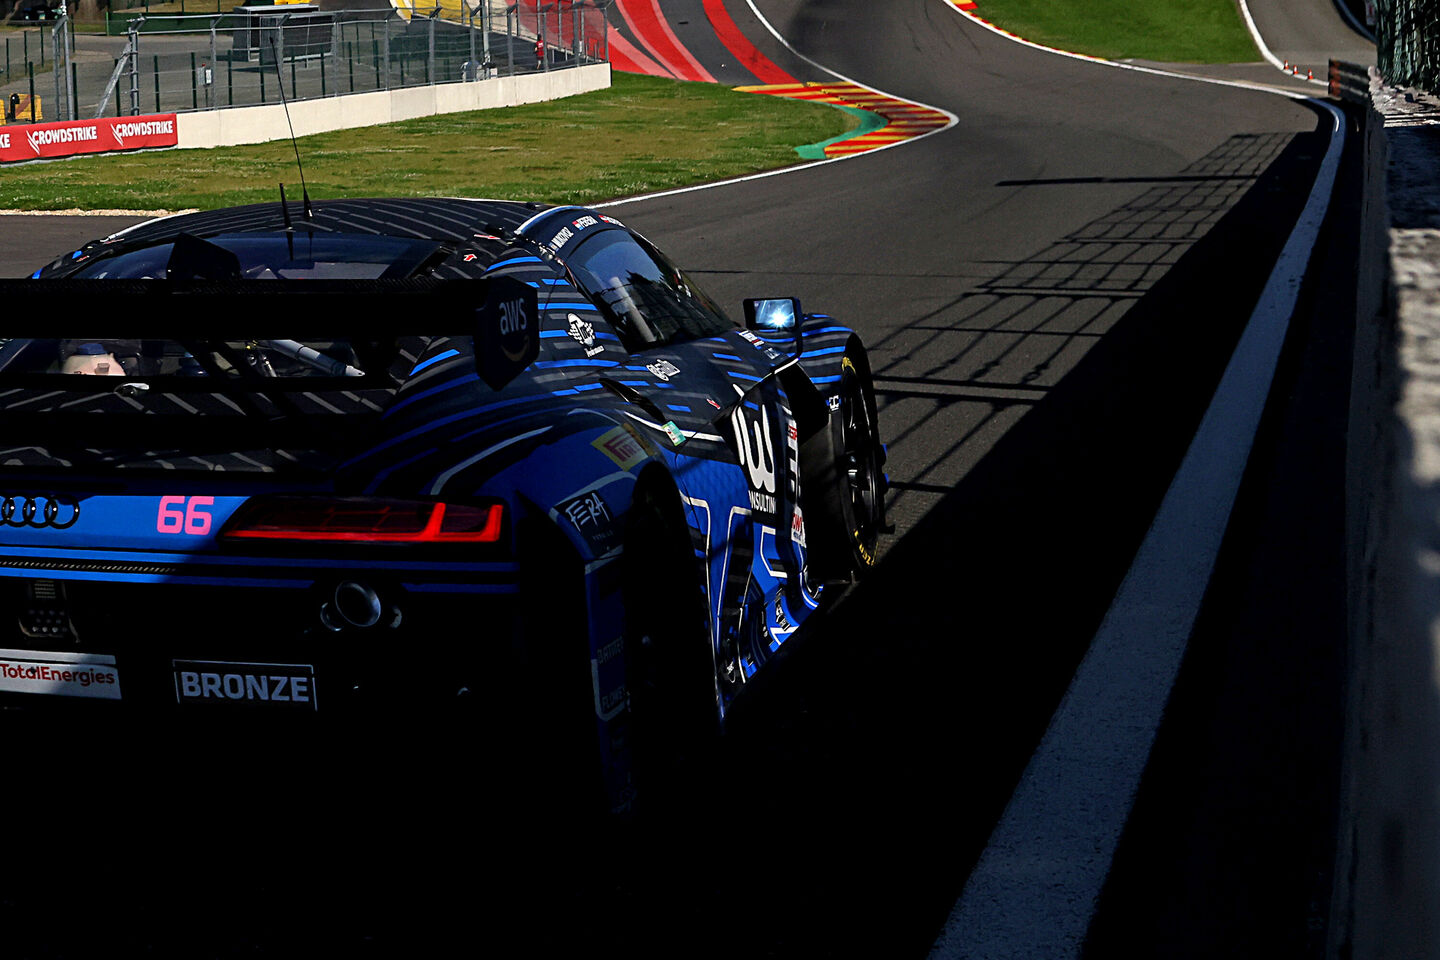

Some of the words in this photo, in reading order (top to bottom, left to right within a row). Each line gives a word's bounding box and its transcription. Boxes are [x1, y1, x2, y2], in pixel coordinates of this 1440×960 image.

[32, 126, 98, 145] CROWDSTRIKE
[116, 120, 174, 138] CROWDSTRIKE
[498, 297, 527, 335] aws
[157, 496, 214, 535] 66
[181, 671, 309, 702] BRONZE
